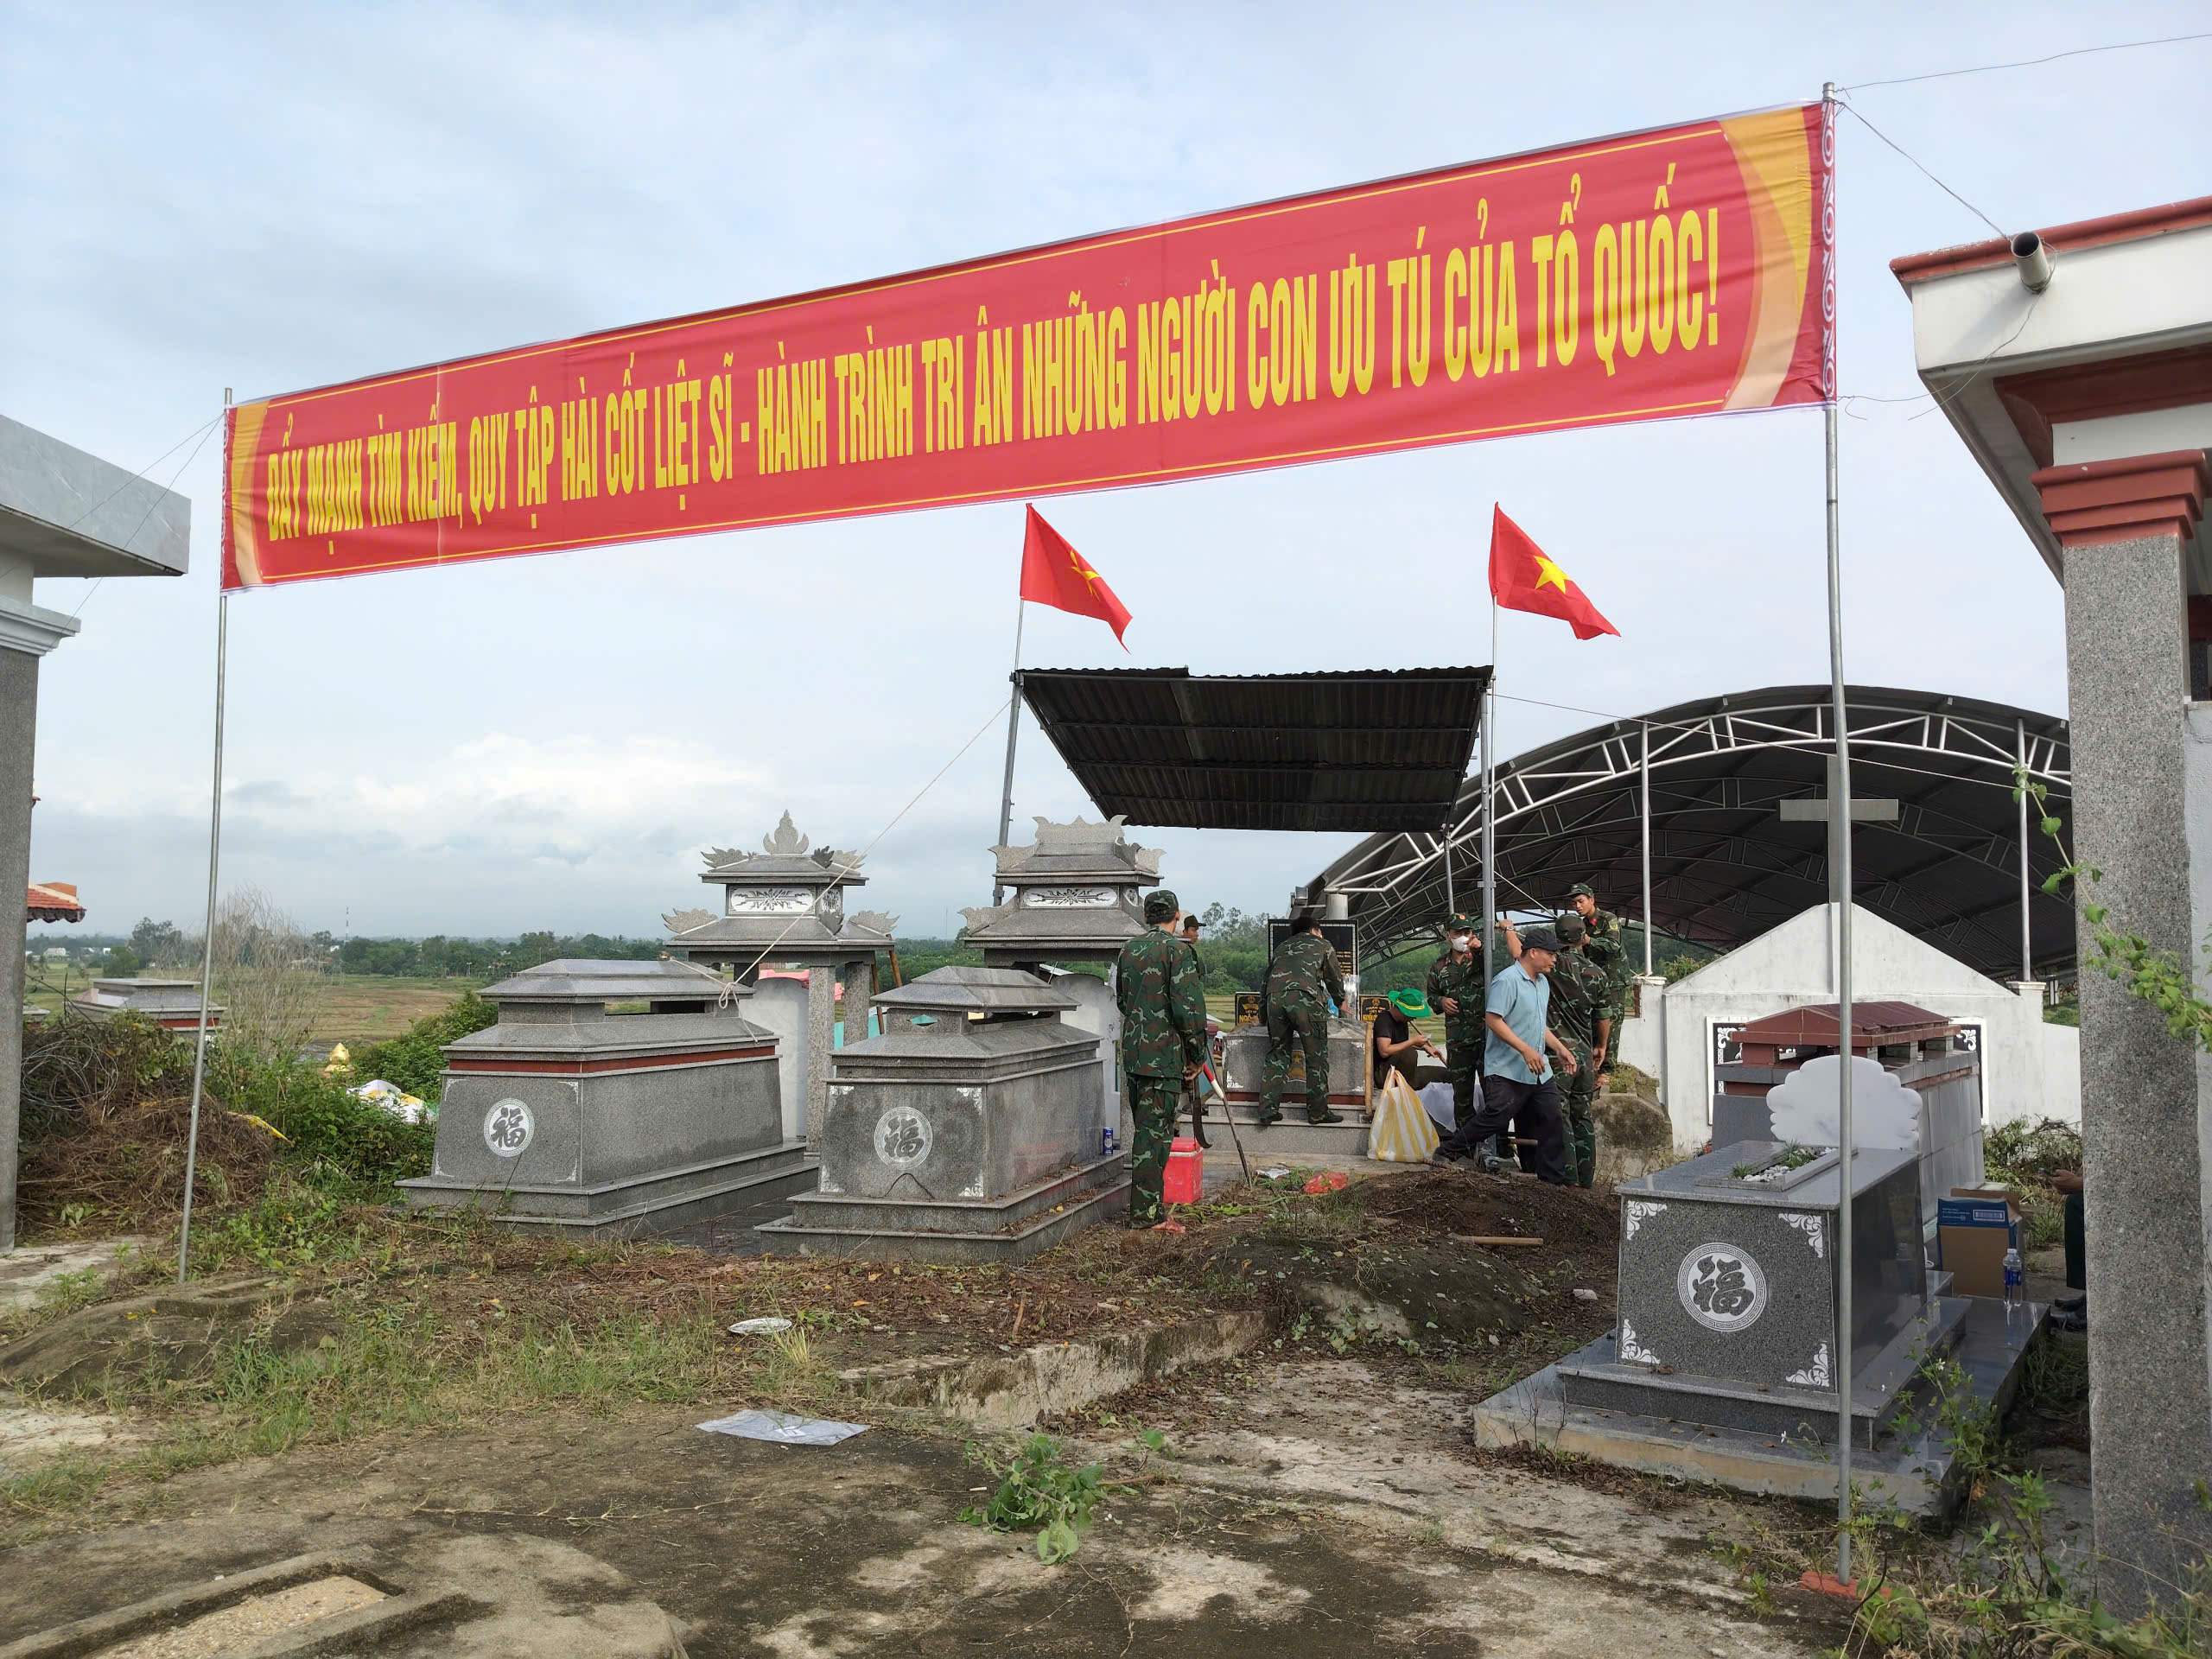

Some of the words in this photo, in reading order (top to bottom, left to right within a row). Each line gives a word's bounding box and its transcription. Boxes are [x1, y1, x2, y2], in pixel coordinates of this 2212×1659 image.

[307, 438, 364, 556] MẠNH
[367, 414, 403, 525] TÌM
[407, 391, 463, 530] KIẾM,
[469, 411, 510, 526] QUY
[514, 385, 554, 528] TẬP
[562, 376, 598, 500] HÀI
[604, 352, 646, 496] CỐT
[654, 359, 701, 511] LIỆT
[709, 352, 733, 482] SĨ
[758, 341, 827, 474] HÀNH
[835, 325, 912, 463] TRÌNH
[921, 335, 963, 453] TRI
[974, 305, 1012, 446] ÂN
[1023, 290, 1127, 439] NHỮNG
[1138, 259, 1236, 423] NGƯỜI
[1248, 275, 1317, 408] CON
[1330, 253, 1375, 397] ƯU
[1388, 226, 1430, 387] TÚ
[1445, 198, 1519, 381] CỦA
[1532, 173, 1580, 367] TỔ
[1593, 162, 1718, 376] QUỐC!
[491, 1106, 527, 1148] 福
[883, 1116, 925, 1159] 福
[1692, 1255, 1755, 1317] 福
